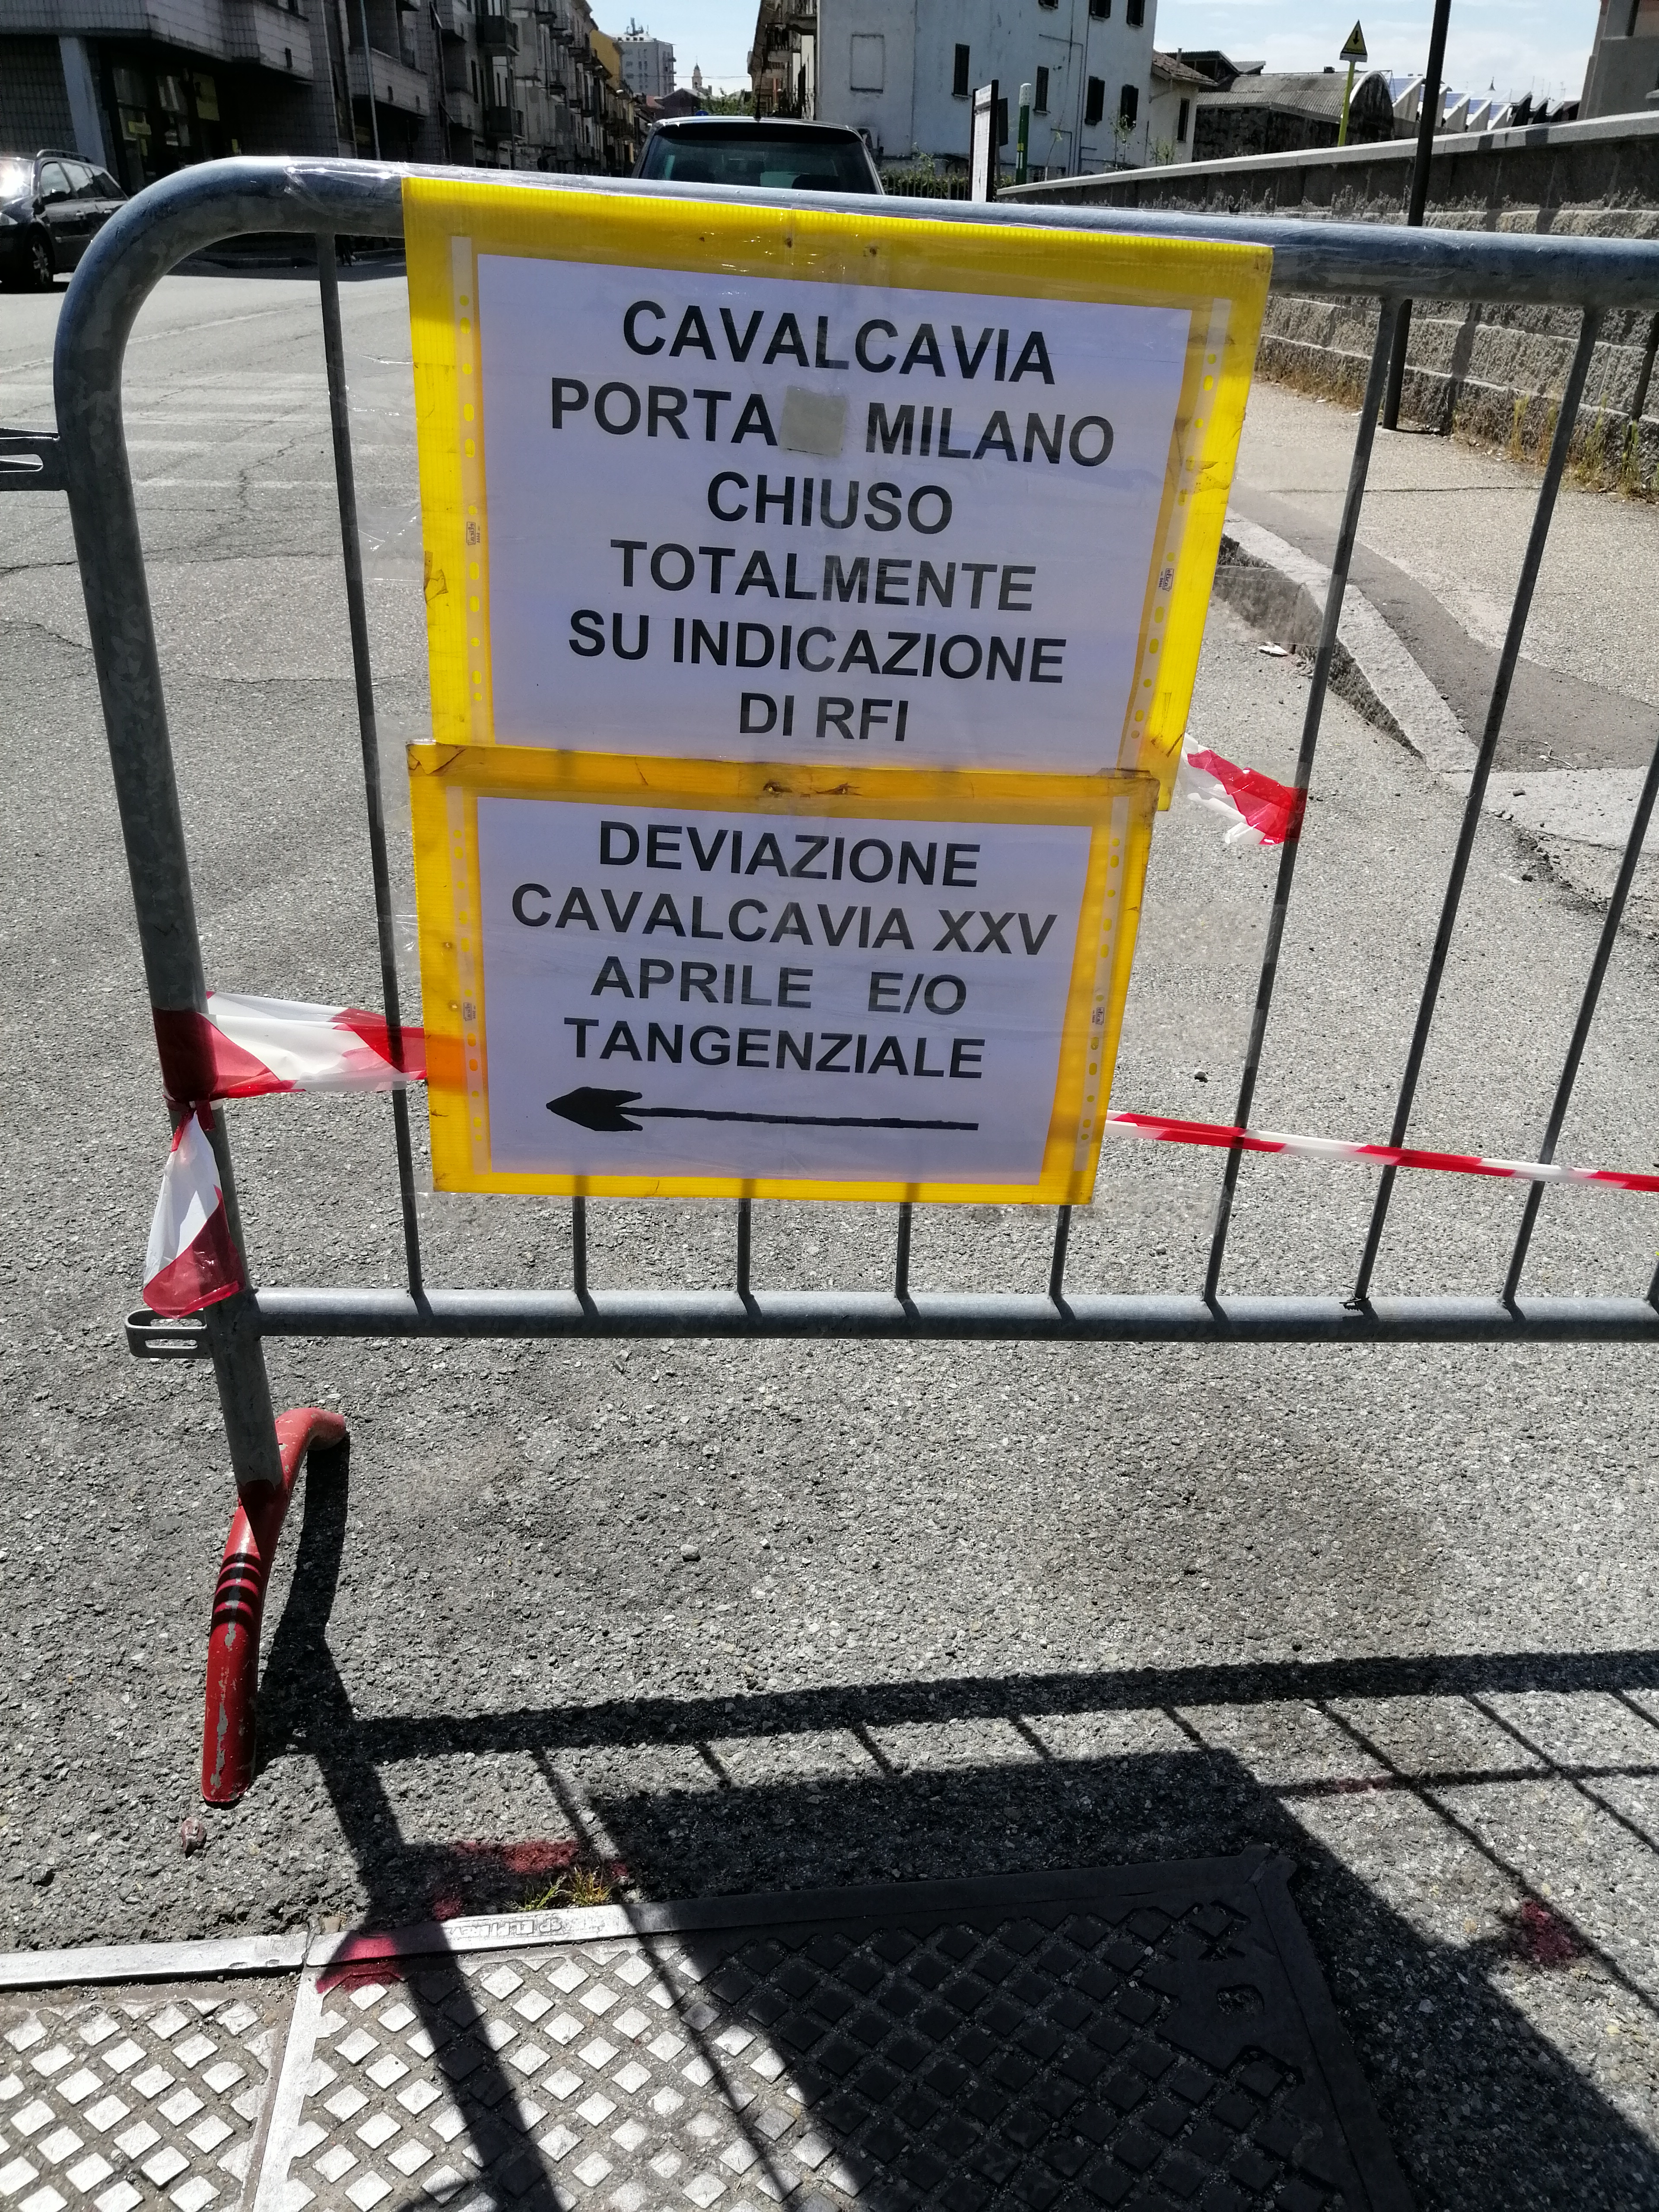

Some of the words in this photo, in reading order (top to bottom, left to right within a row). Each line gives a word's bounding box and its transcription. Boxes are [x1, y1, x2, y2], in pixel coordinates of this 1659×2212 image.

[623, 301, 1055, 385] CAVALCAVIA
[552, 378, 778, 446] PORTA
[866, 402, 1113, 467] MILANO
[708, 471, 952, 534] CHIUSO
[610, 539, 1036, 611] TOTALMENTE
[569, 610, 649, 660] SU
[674, 618, 1066, 683] INDICAZIONE
[740, 693, 794, 736] DI
[816, 697, 908, 741] RFI
[600, 821, 980, 887] DEVIAZIONE
[512, 884, 914, 950] CAVALCAVIA
[932, 910, 1057, 955] XXV
[591, 956, 813, 1008] APRILE
[868, 972, 966, 1015] E/O
[564, 1017, 985, 1078] TANGENZIALE
